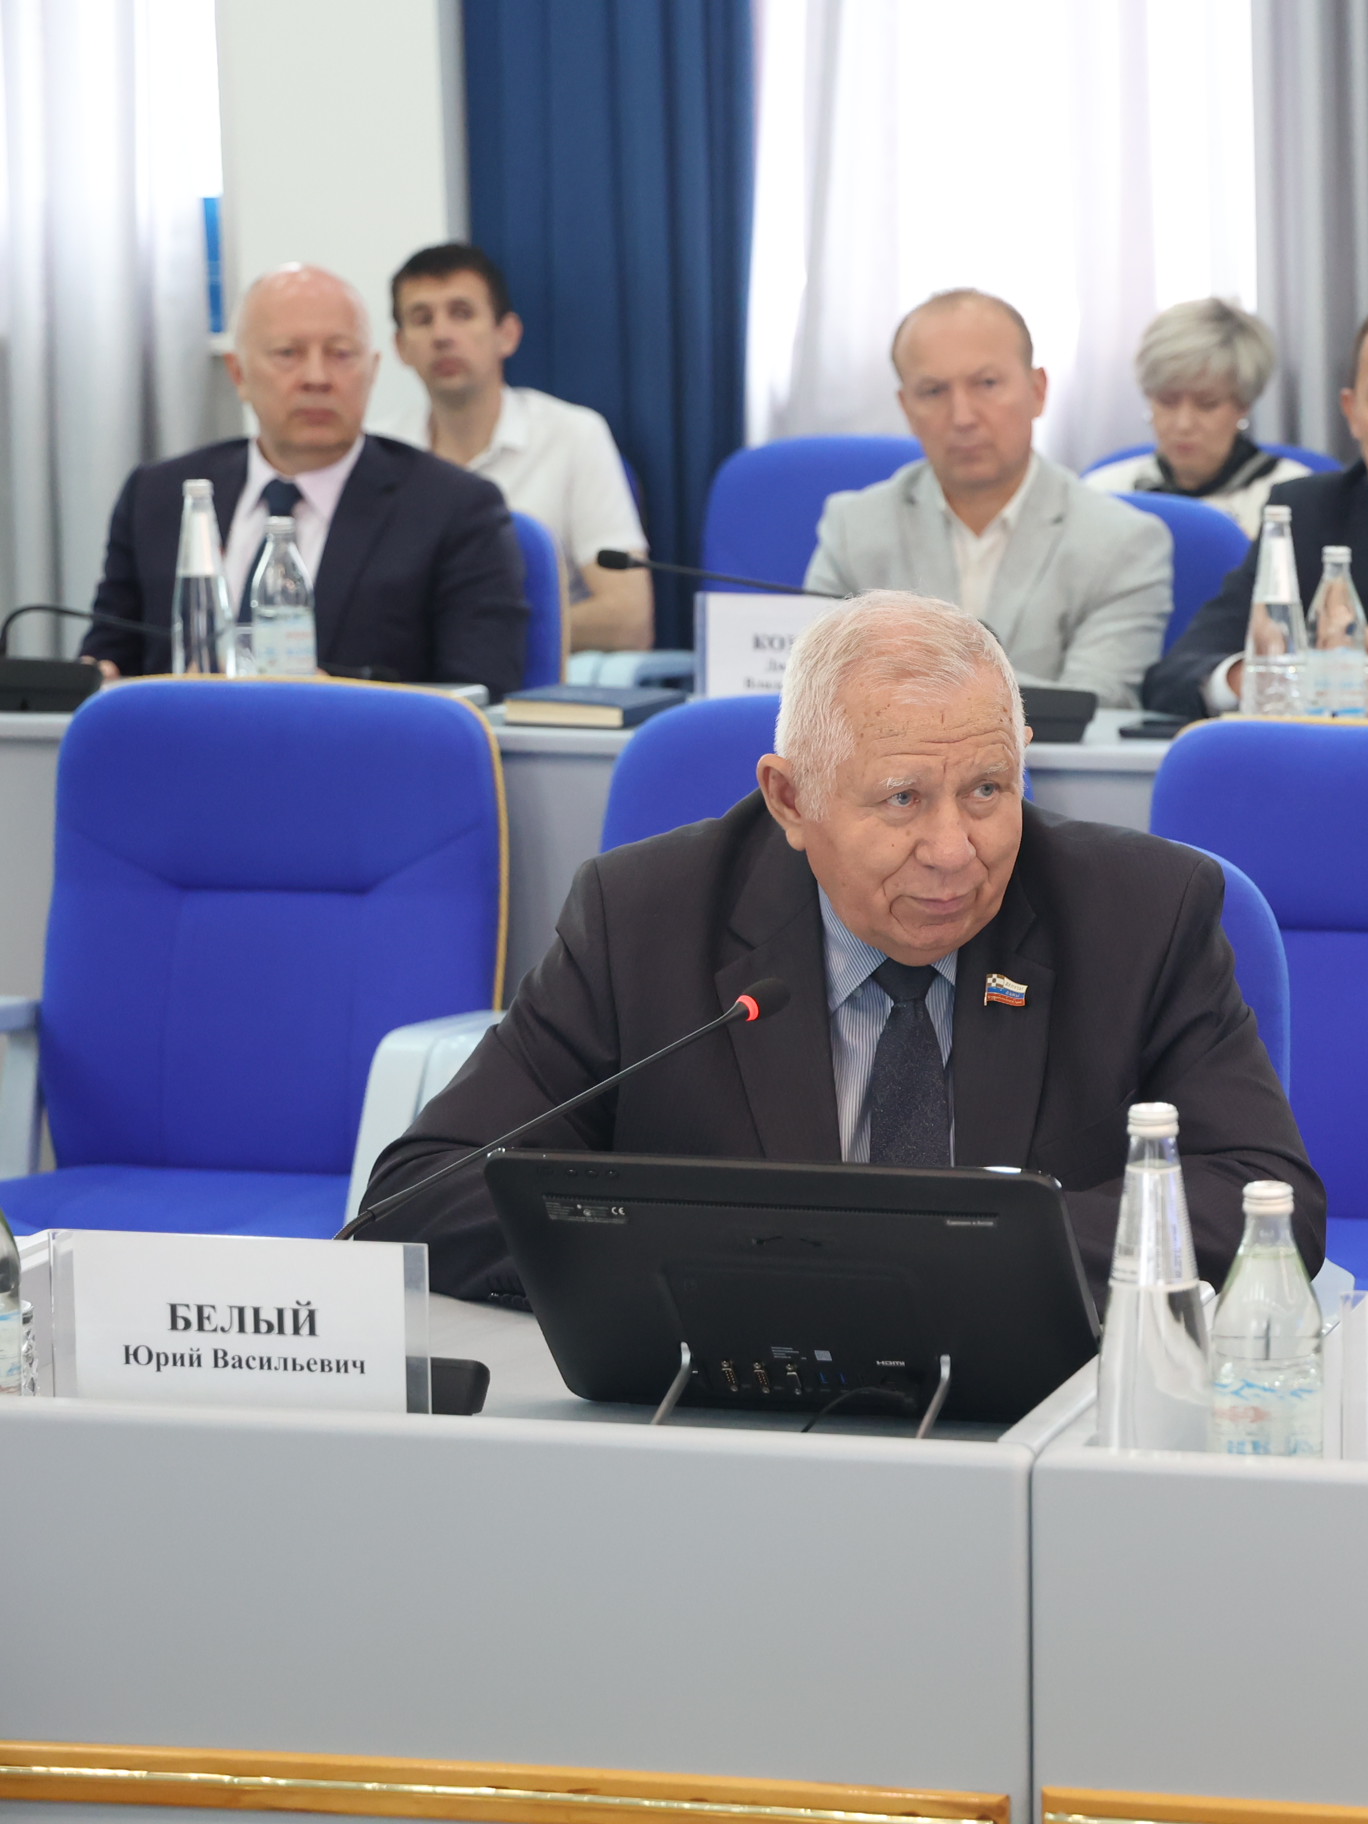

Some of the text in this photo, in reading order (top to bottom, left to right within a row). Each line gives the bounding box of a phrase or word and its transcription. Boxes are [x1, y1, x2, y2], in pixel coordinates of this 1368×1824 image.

[167, 1300, 319, 1337] БЕЛЫЙ
[123, 1344, 366, 1375] Юрий Васильевич
